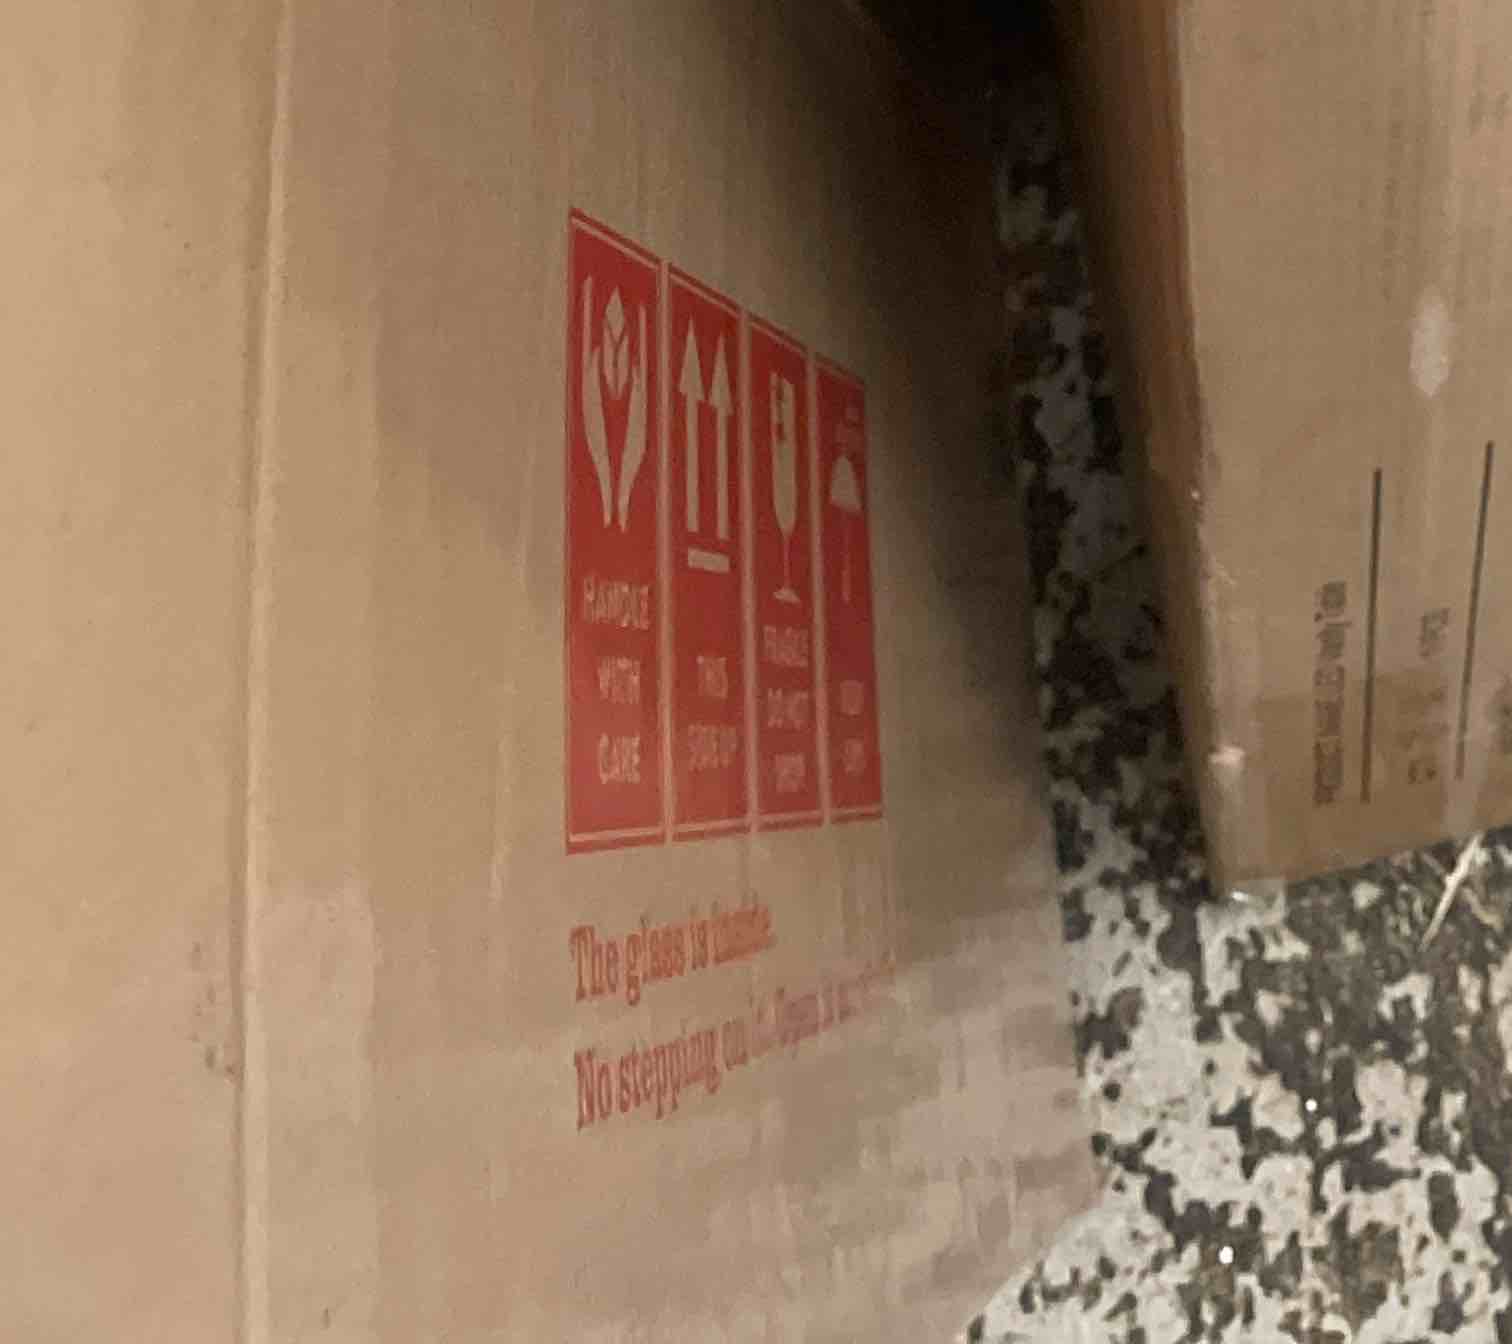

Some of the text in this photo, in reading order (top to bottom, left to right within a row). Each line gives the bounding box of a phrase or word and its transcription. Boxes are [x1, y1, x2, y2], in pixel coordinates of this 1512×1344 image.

[569, 923, 620, 1003] The
[574, 1047, 614, 1133] No
[617, 1025, 722, 1122] stepping
